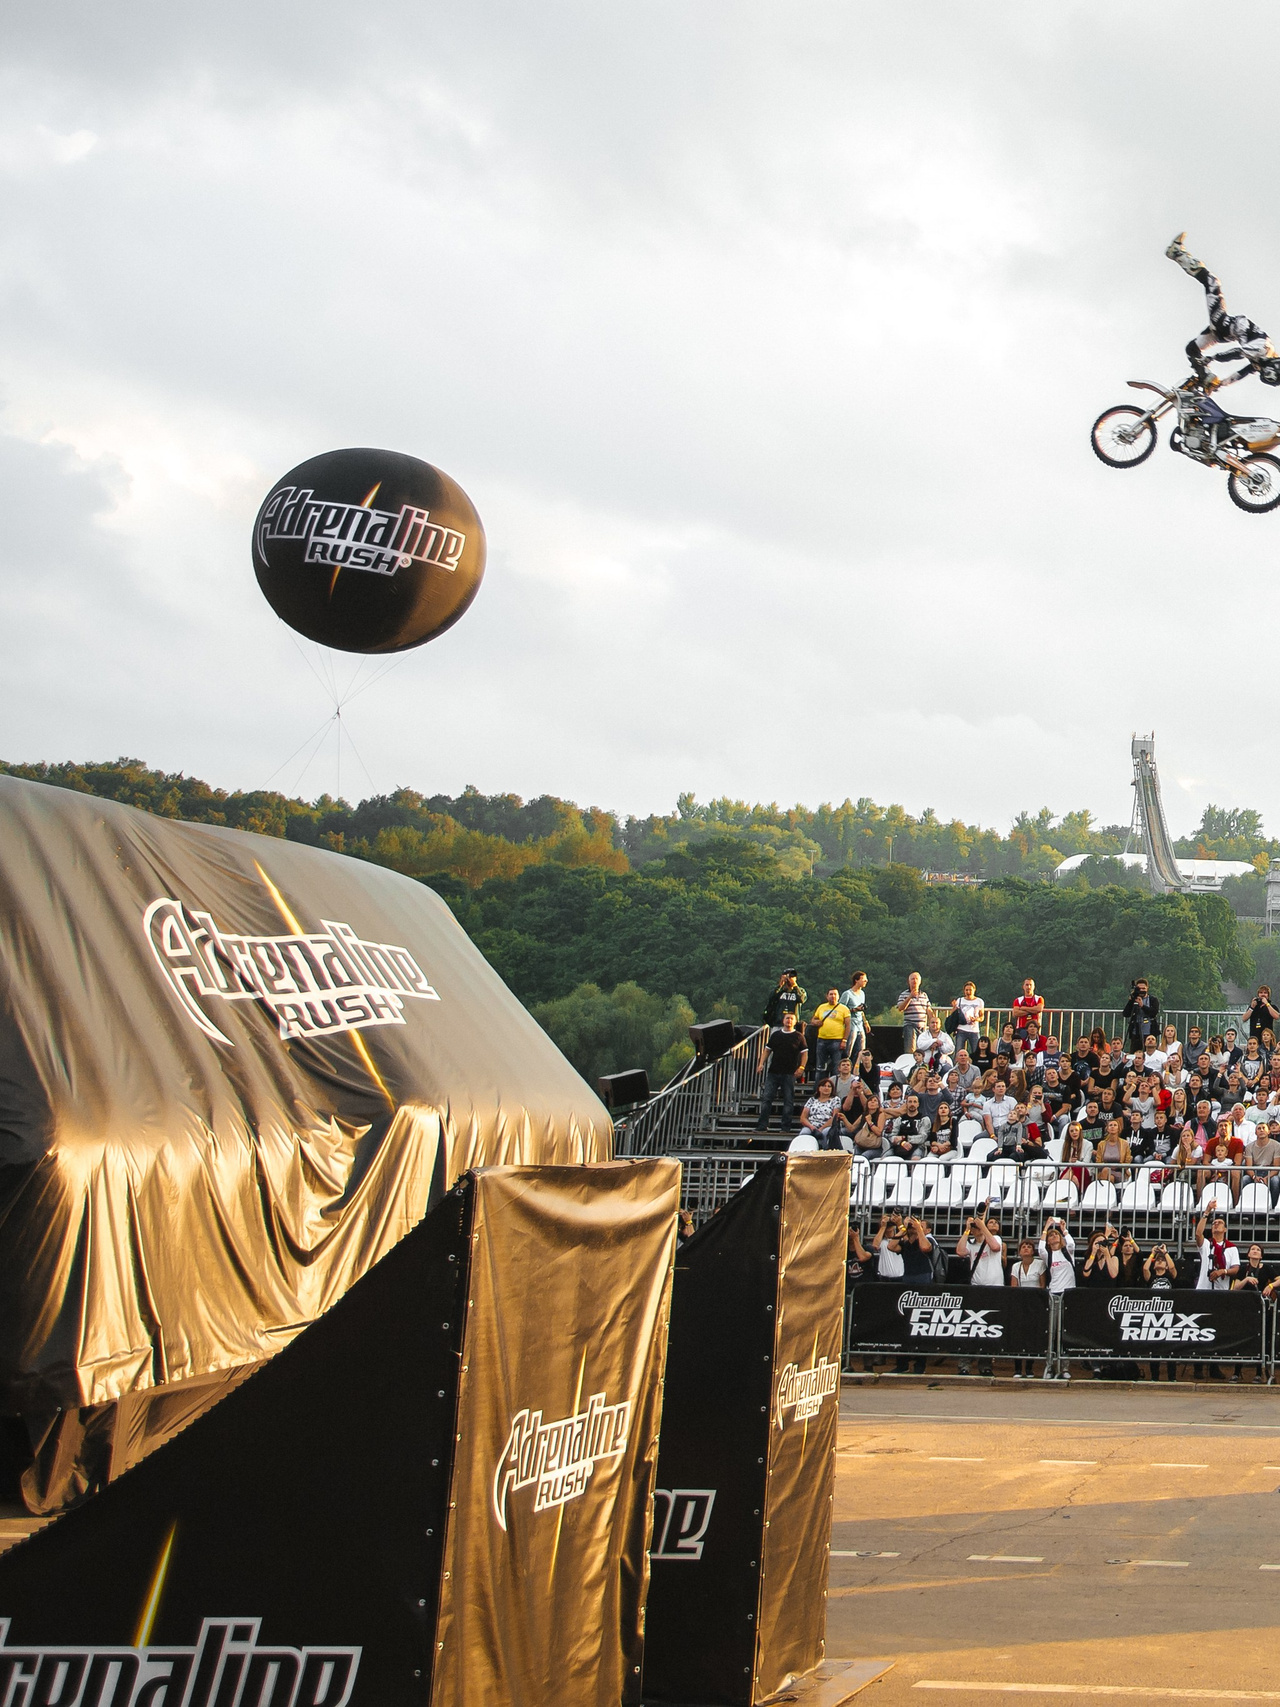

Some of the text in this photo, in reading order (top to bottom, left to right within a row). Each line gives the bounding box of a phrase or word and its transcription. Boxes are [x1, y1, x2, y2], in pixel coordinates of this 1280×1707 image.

[256, 486, 466, 571] Adrenaline
[143, 897, 441, 1046] Adrenaline
[898, 1290, 963, 1316] Adrenaline
[1108, 1295, 1174, 1320] Adrenaline
[910, 1308, 1000, 1325] FMX
[1120, 1313, 1212, 1328] FMX
[909, 1322, 1004, 1338] RIDERS
[1120, 1327, 1217, 1341] RIDERS
[776, 1356, 839, 1430] Adrenaline
[493, 1392, 631, 1532] Adrenaline
